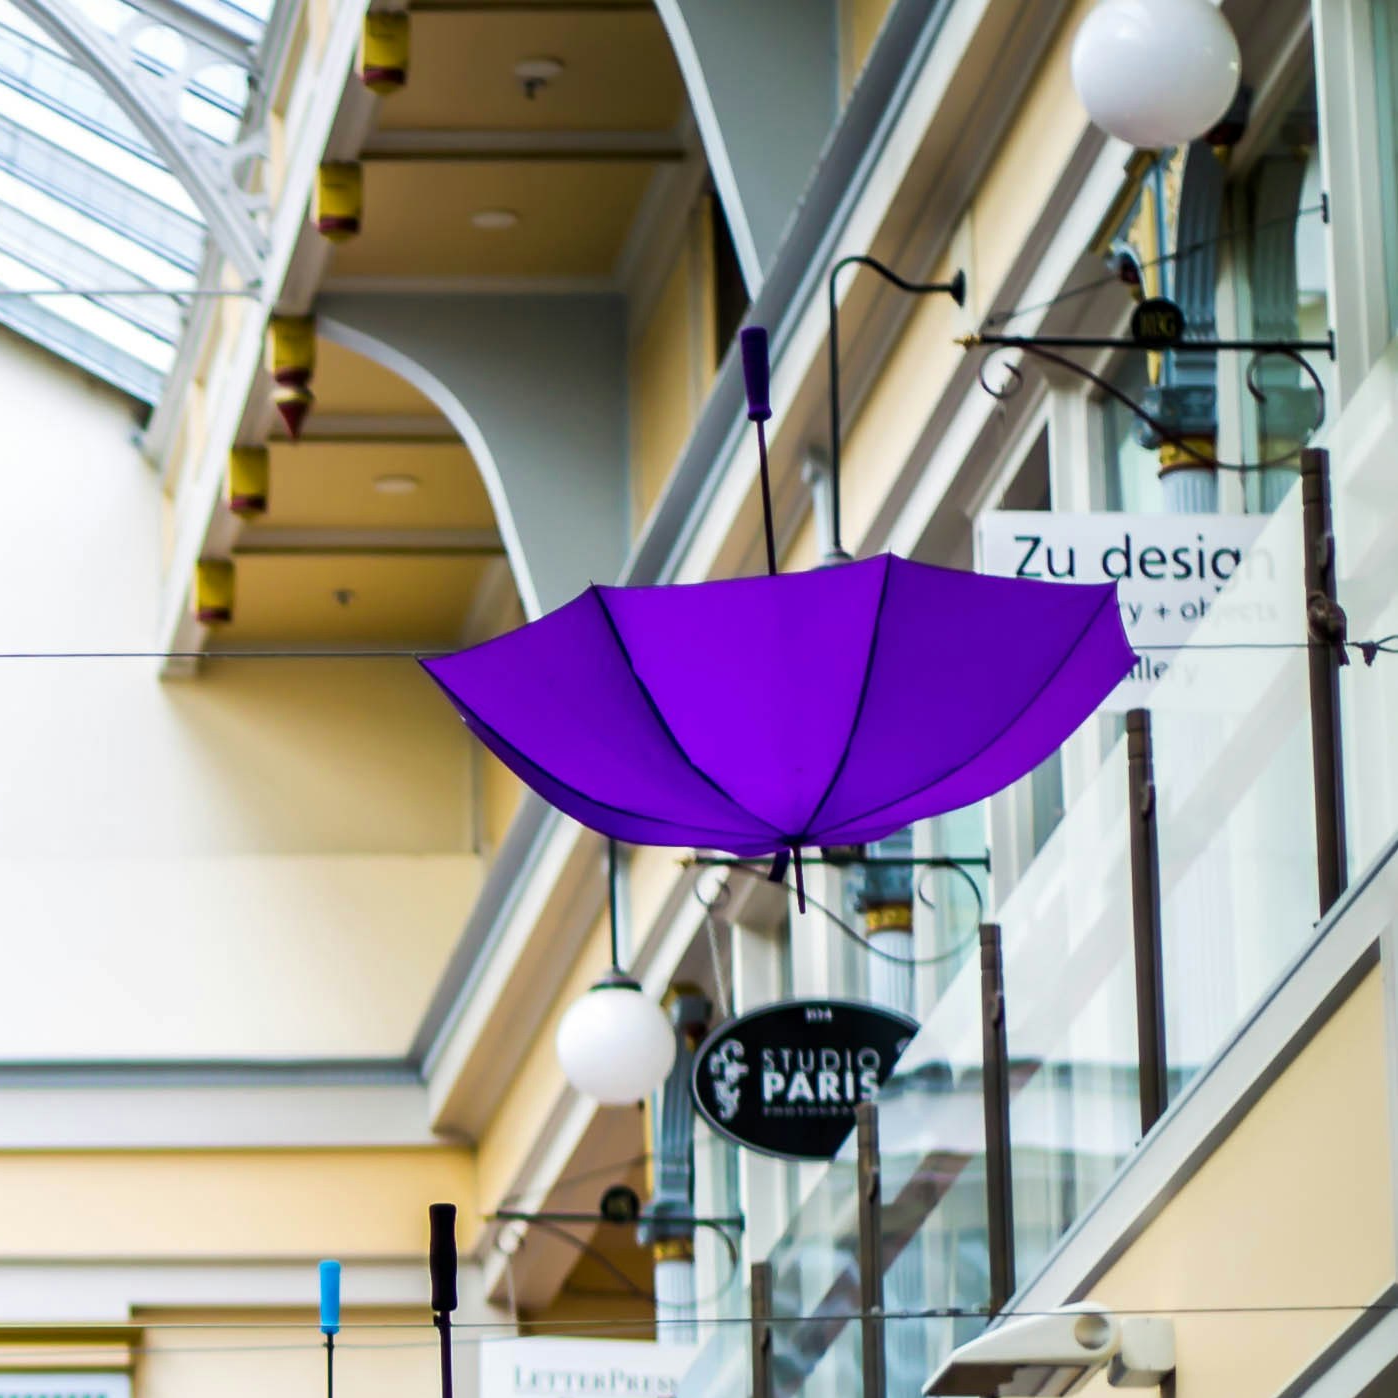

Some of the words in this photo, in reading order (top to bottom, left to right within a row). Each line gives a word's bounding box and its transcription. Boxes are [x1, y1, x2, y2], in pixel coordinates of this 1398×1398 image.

[1014, 535, 1076, 577] Zu
[761, 1048, 881, 1073] STUDIO
[762, 1071, 879, 1102] PARIS
